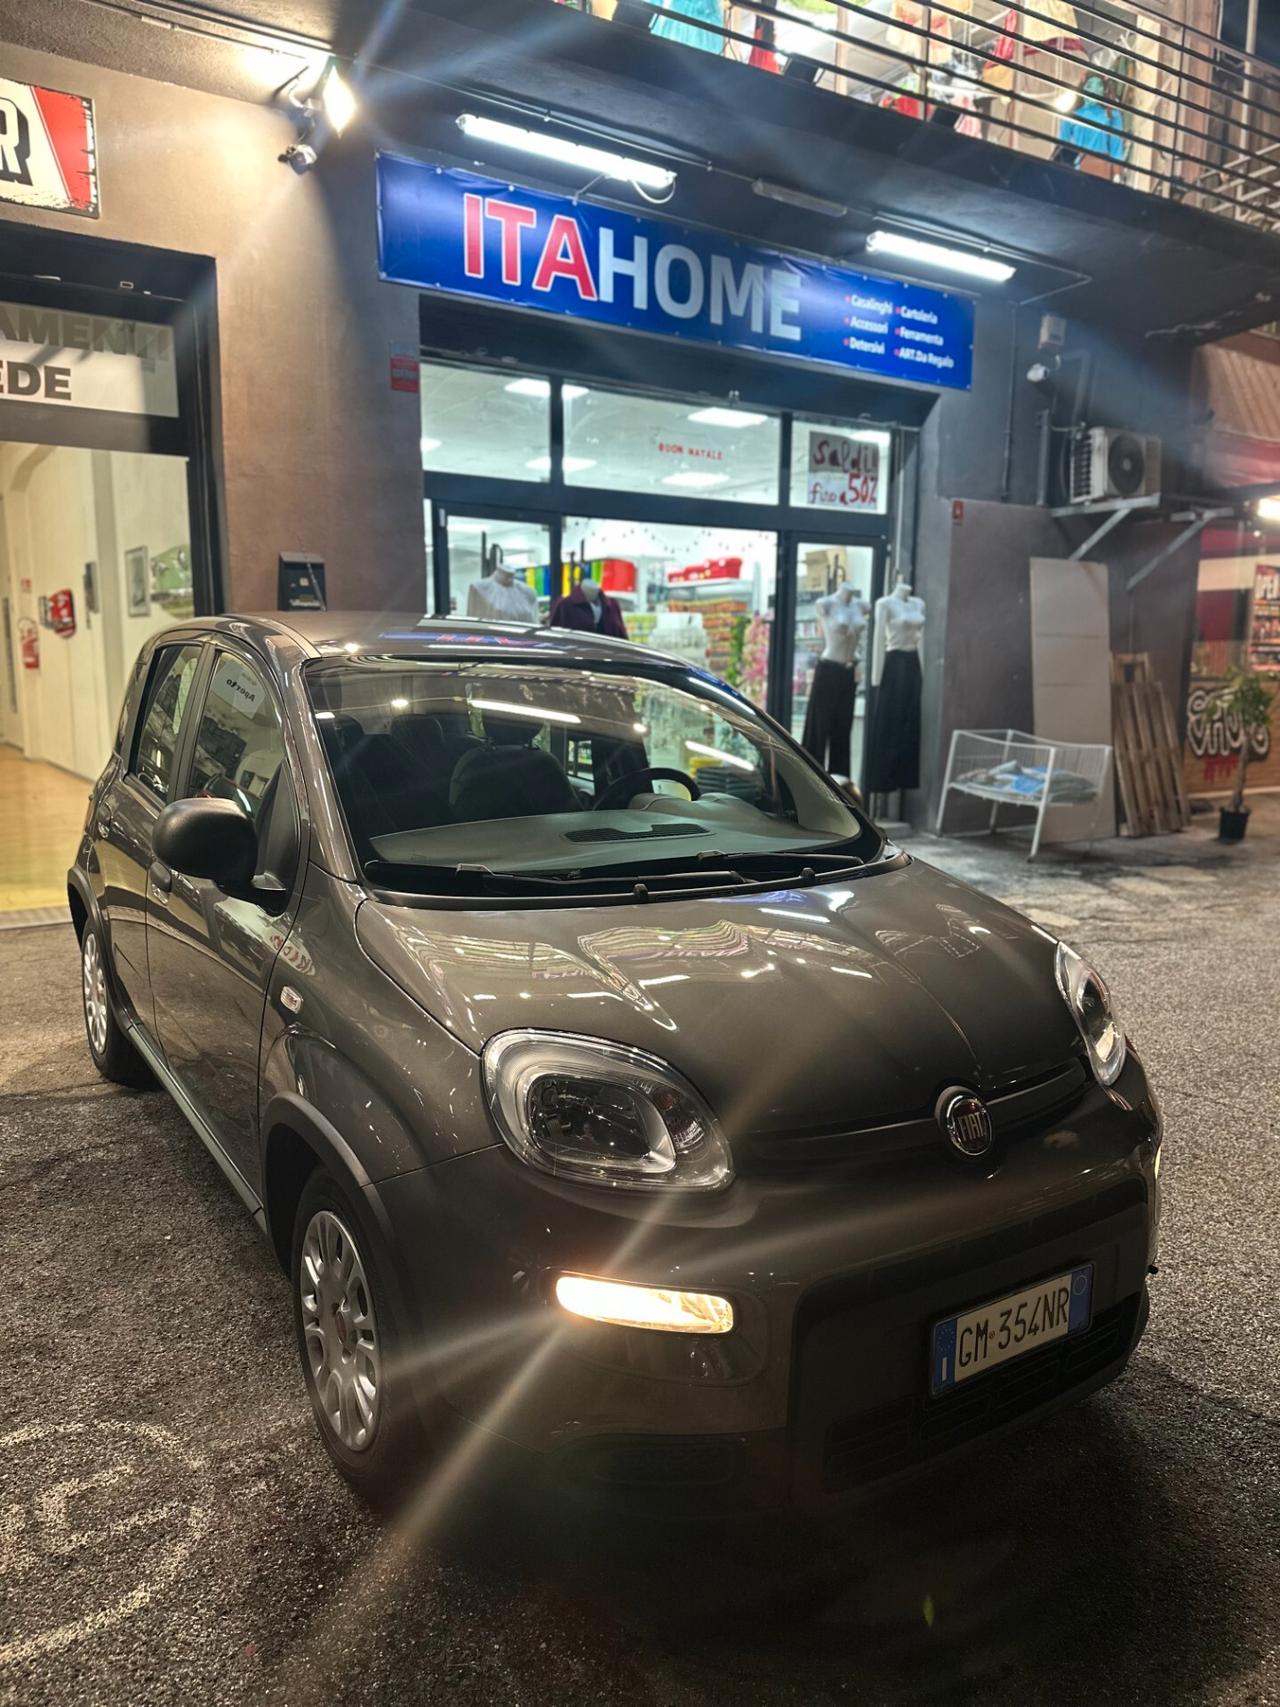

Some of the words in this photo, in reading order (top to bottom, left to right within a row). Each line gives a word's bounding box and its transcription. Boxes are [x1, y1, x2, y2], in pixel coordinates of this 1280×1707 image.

[463, 192, 801, 341] ITAHOME
[850, 316, 888, 334] Accessori
[849, 336, 885, 354] Detersivi
[958, 1111, 985, 1141] FIAT
